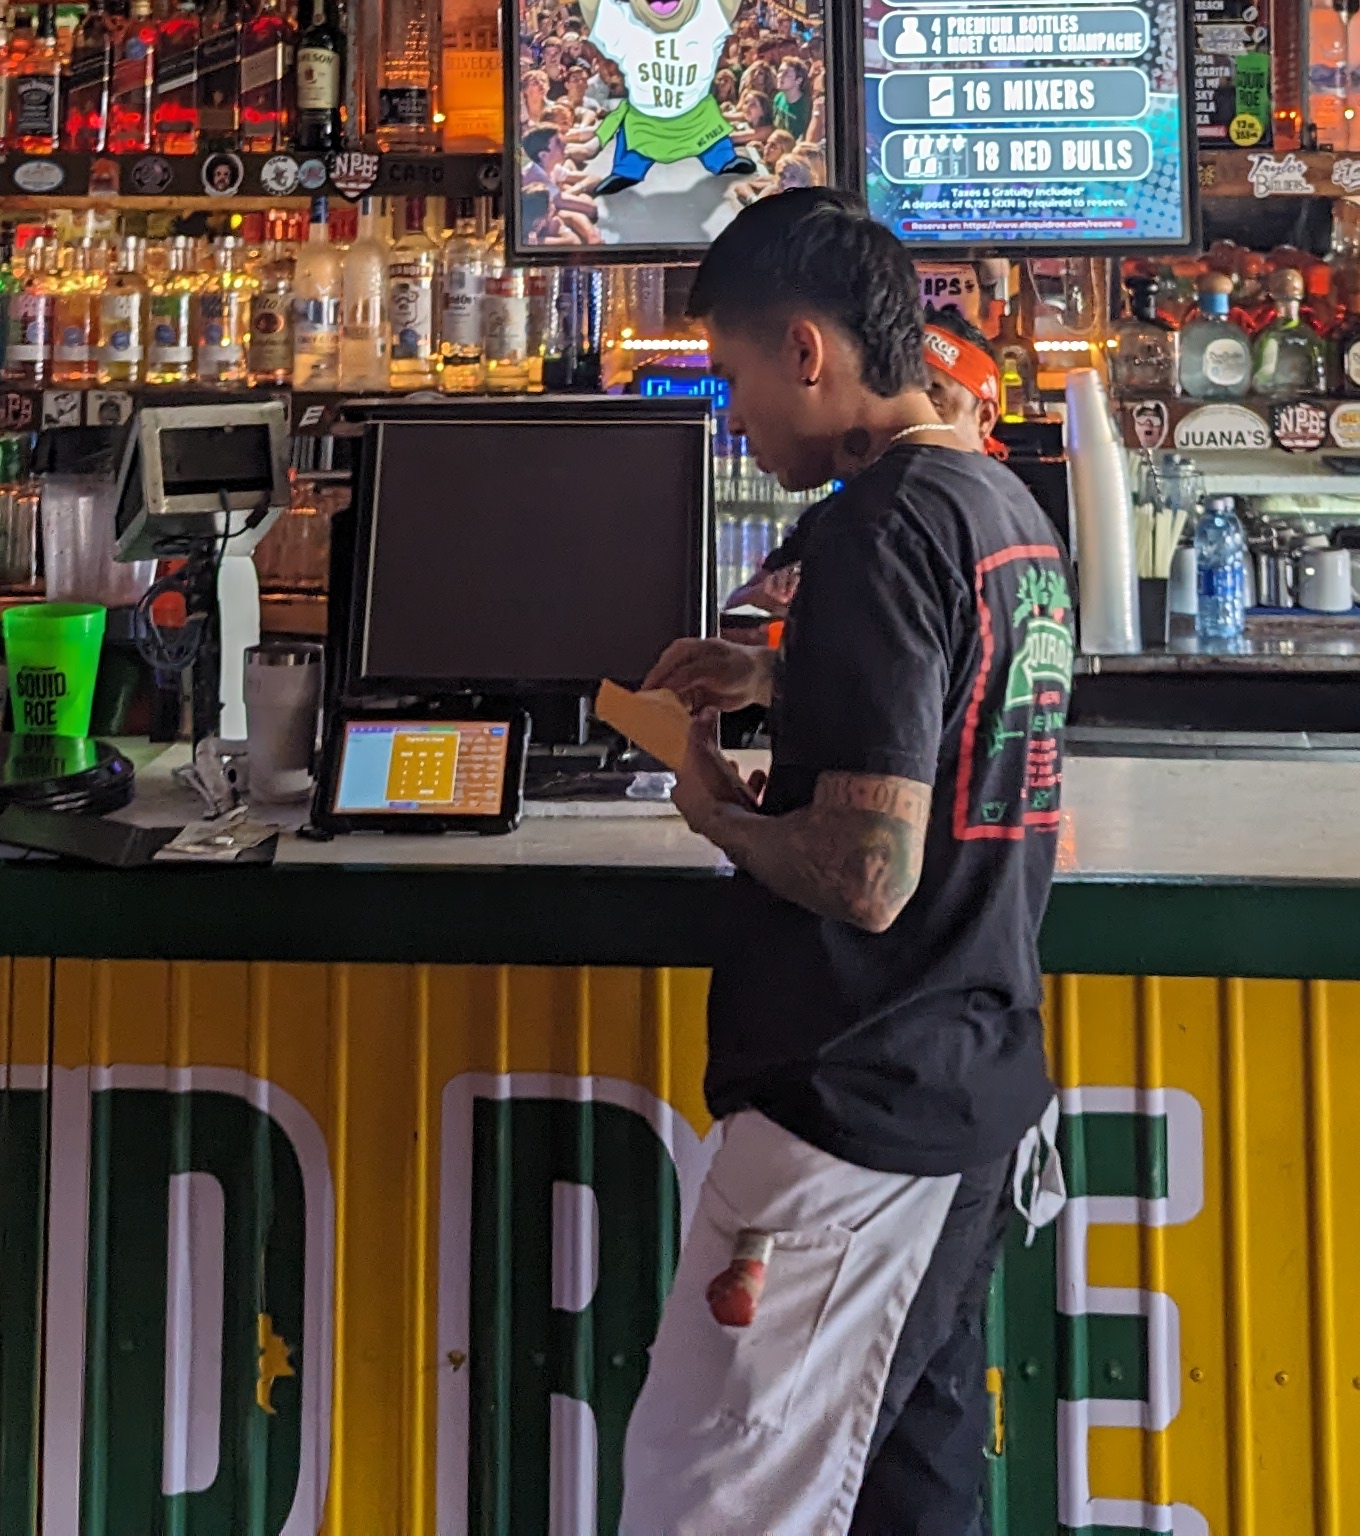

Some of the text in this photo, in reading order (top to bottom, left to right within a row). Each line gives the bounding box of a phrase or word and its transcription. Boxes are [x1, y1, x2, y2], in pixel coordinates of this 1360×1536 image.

[931, 14, 1079, 36] 4 PREMIUM BOTTLES
[653, 39, 680, 62] EL
[931, 31, 1143, 55] 4 MOET CHANDON CHAMPAGNE
[637, 62, 698, 88] SQUID
[652, 85, 684, 110] ROE
[962, 79, 1095, 112] 16 MIXERS
[972, 138, 1133, 172] 18 RED BULLS
[912, 199, 952, 212] deposit
[1028, 198, 1071, 211] required
[950, 186, 1035, 200] Taxes Gratuity
[1179, 429, 1267, 448] JUANA'S
[16, 670, 66, 698] SQUID
[23, 699, 58, 727] ROE
[455, 1076, 1195, 1536] RE
